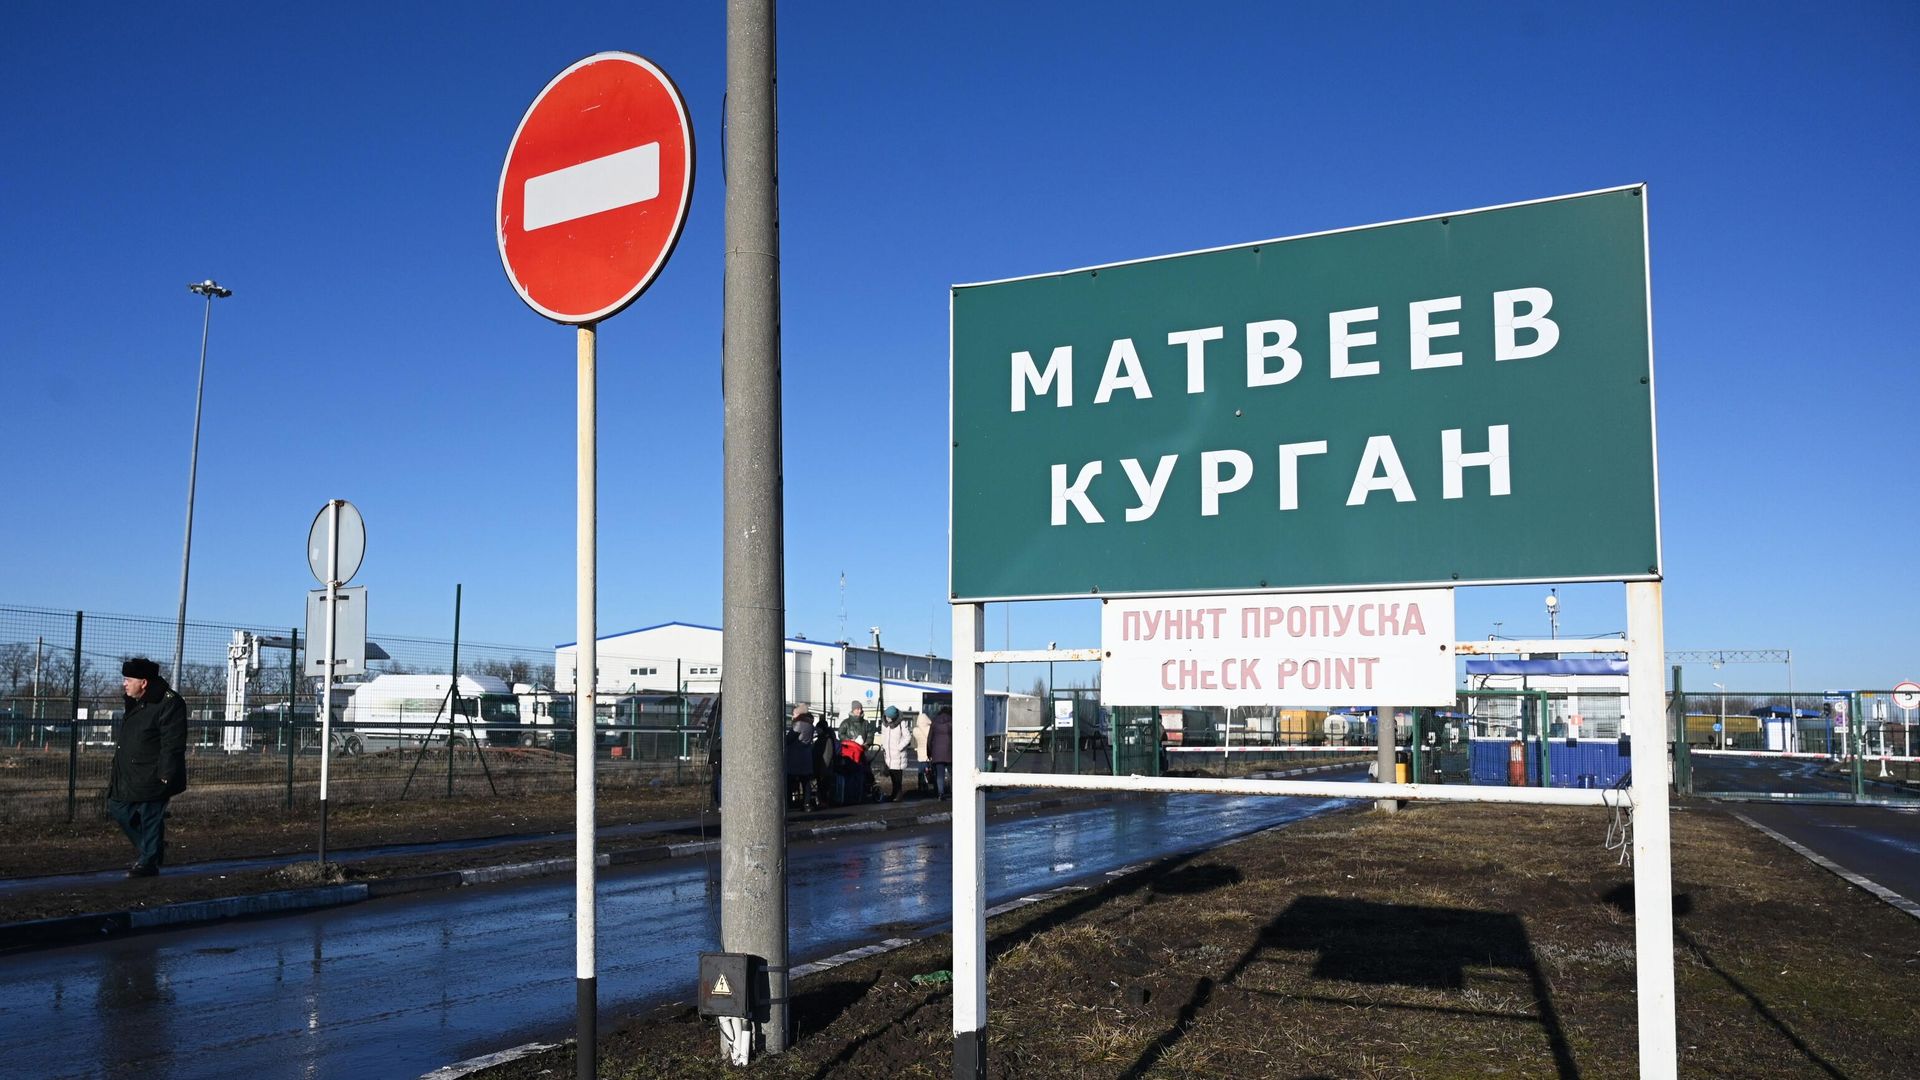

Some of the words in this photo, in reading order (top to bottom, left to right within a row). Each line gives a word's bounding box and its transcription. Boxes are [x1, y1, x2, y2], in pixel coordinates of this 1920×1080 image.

[1010, 287, 1561, 413] МАТВЕЕВ
[1050, 423, 1512, 526] КУРГАН
[1122, 607, 1232, 641] ПУНКТ
[1240, 603, 1426, 637] ПРОПУСКА
[1276, 657, 1381, 689] POINT
